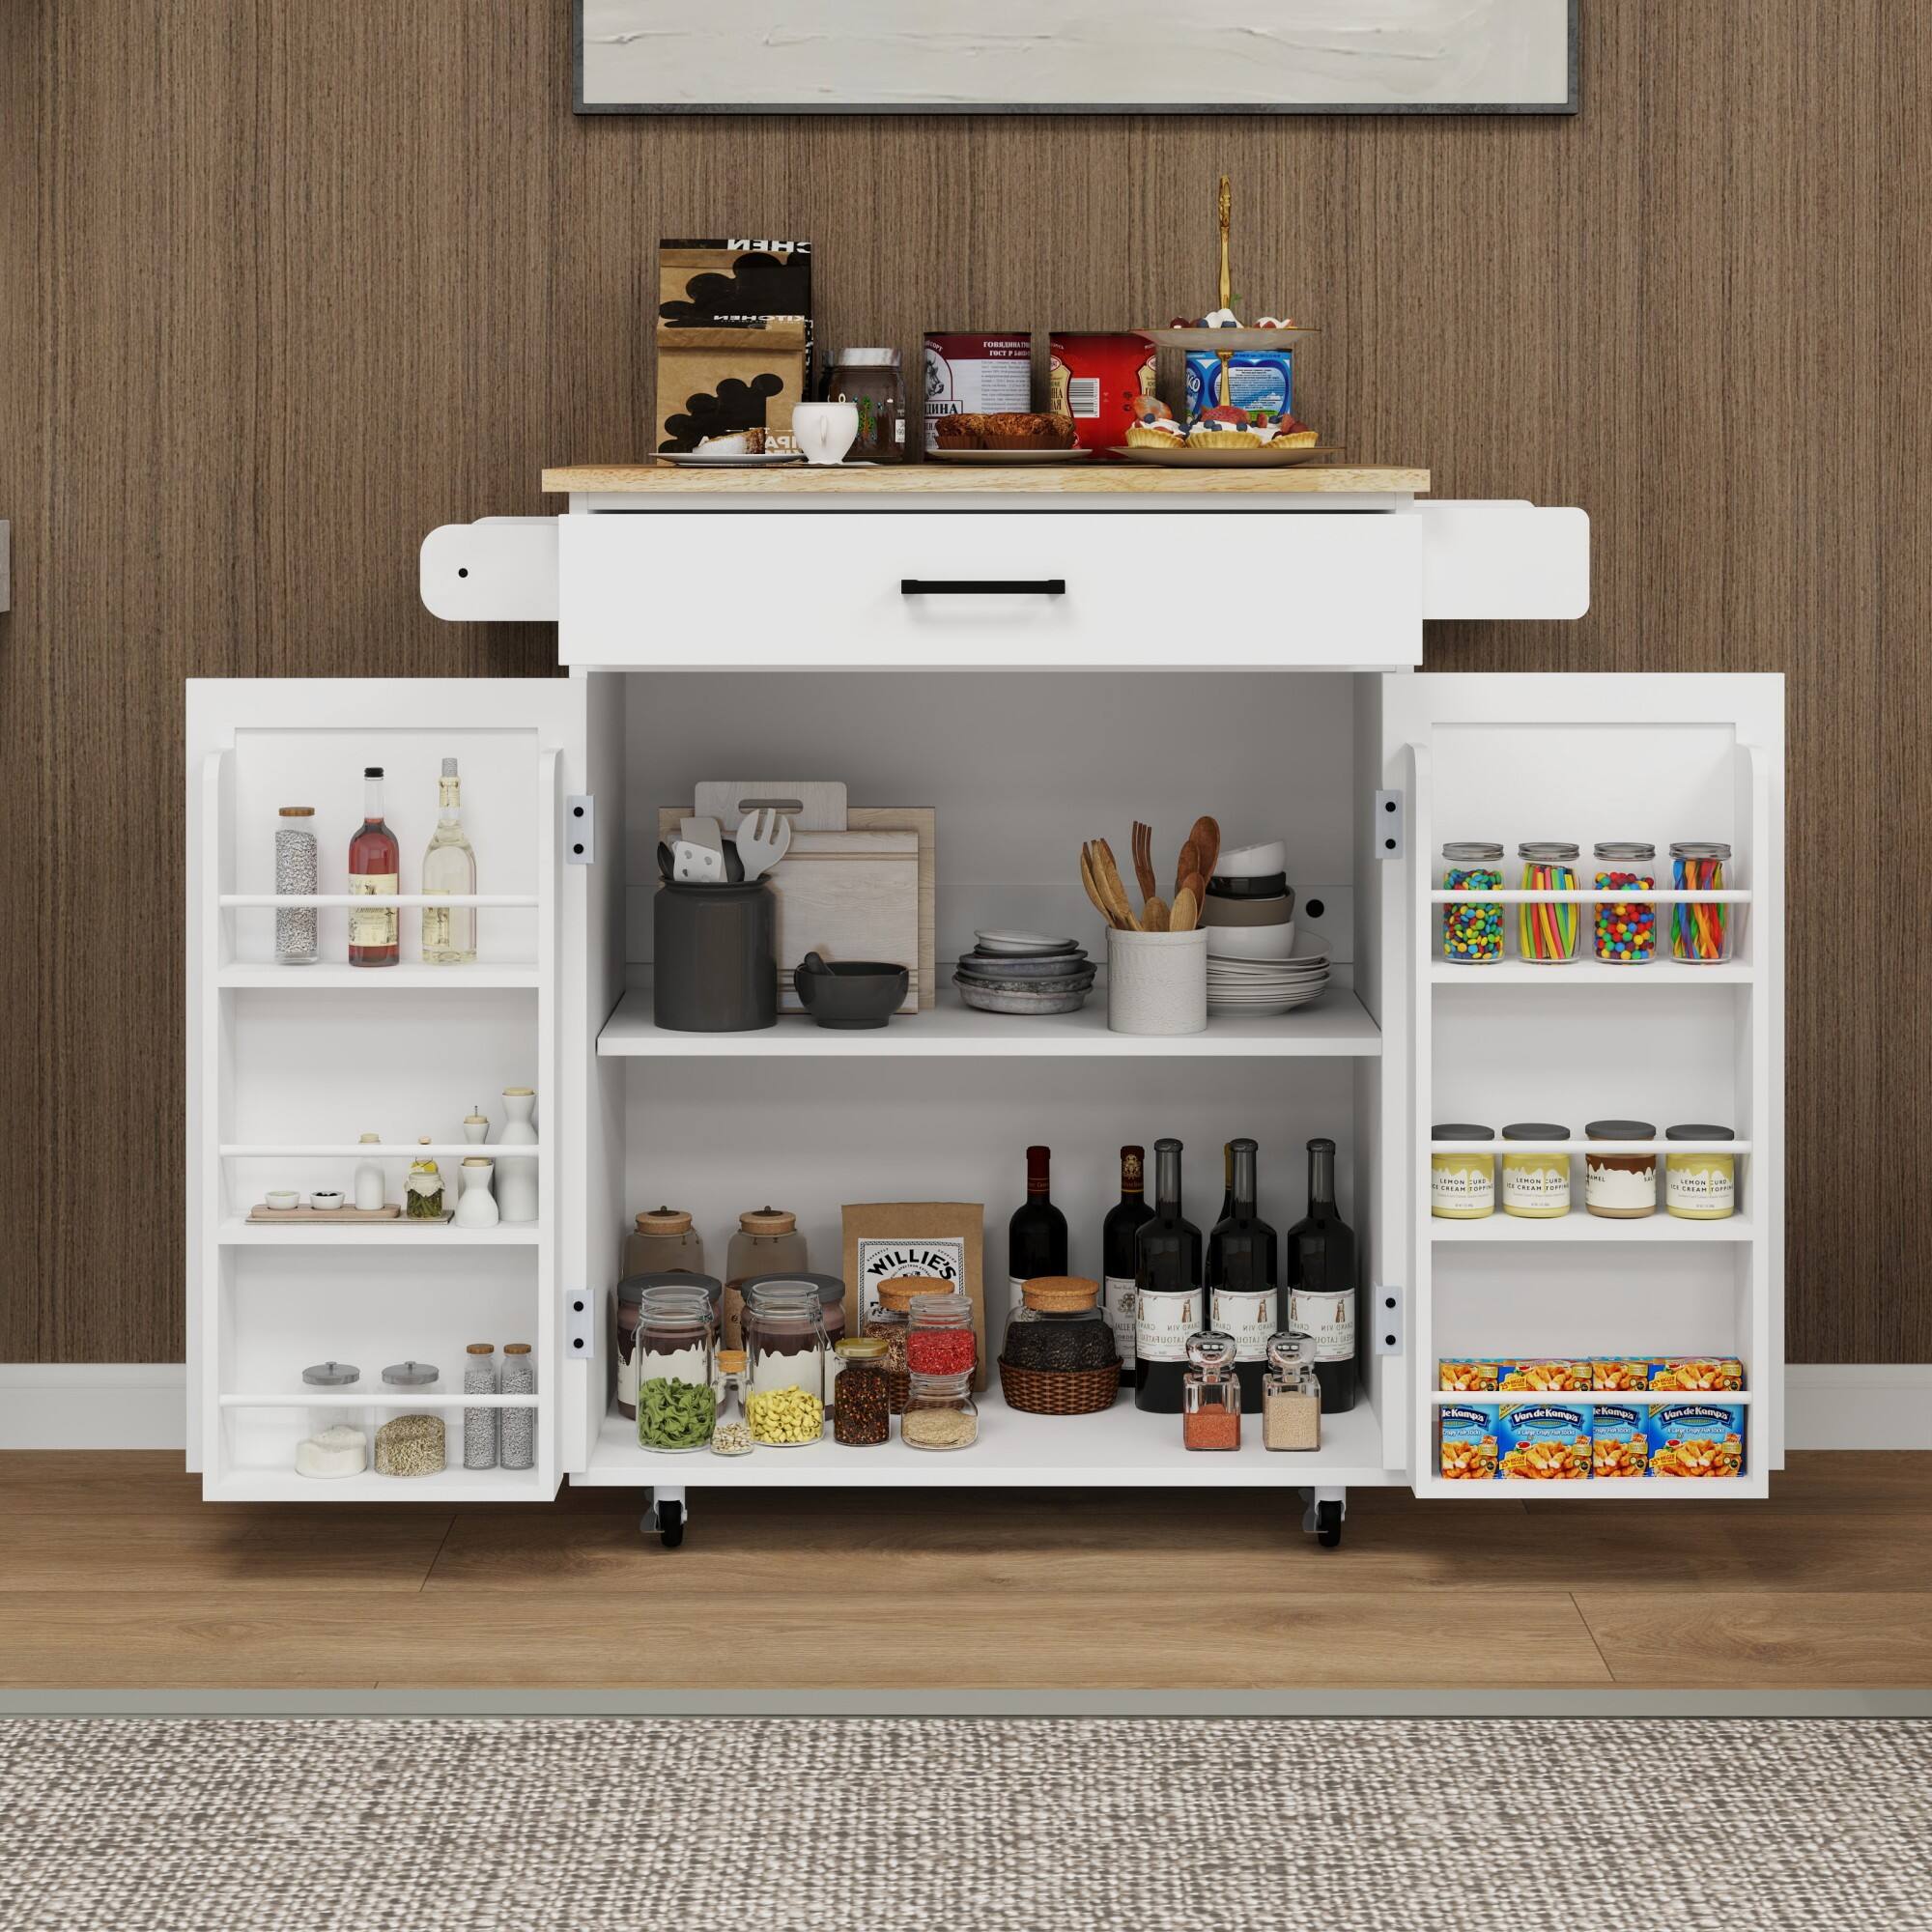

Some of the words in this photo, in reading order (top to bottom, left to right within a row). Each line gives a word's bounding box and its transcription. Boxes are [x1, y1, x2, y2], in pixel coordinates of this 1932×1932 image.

[867, 1249, 956, 1280] WILLIE'S
[1513, 1412, 1533, 1423] Van
[1534, 1408, 1545, 1417] de
[1546, 1408, 1579, 1422] Kamp's
[1663, 1410, 1683, 1421] Van
[1684, 1406, 1694, 1415] de
[1695, 1406, 1728, 1420] Kamp's
